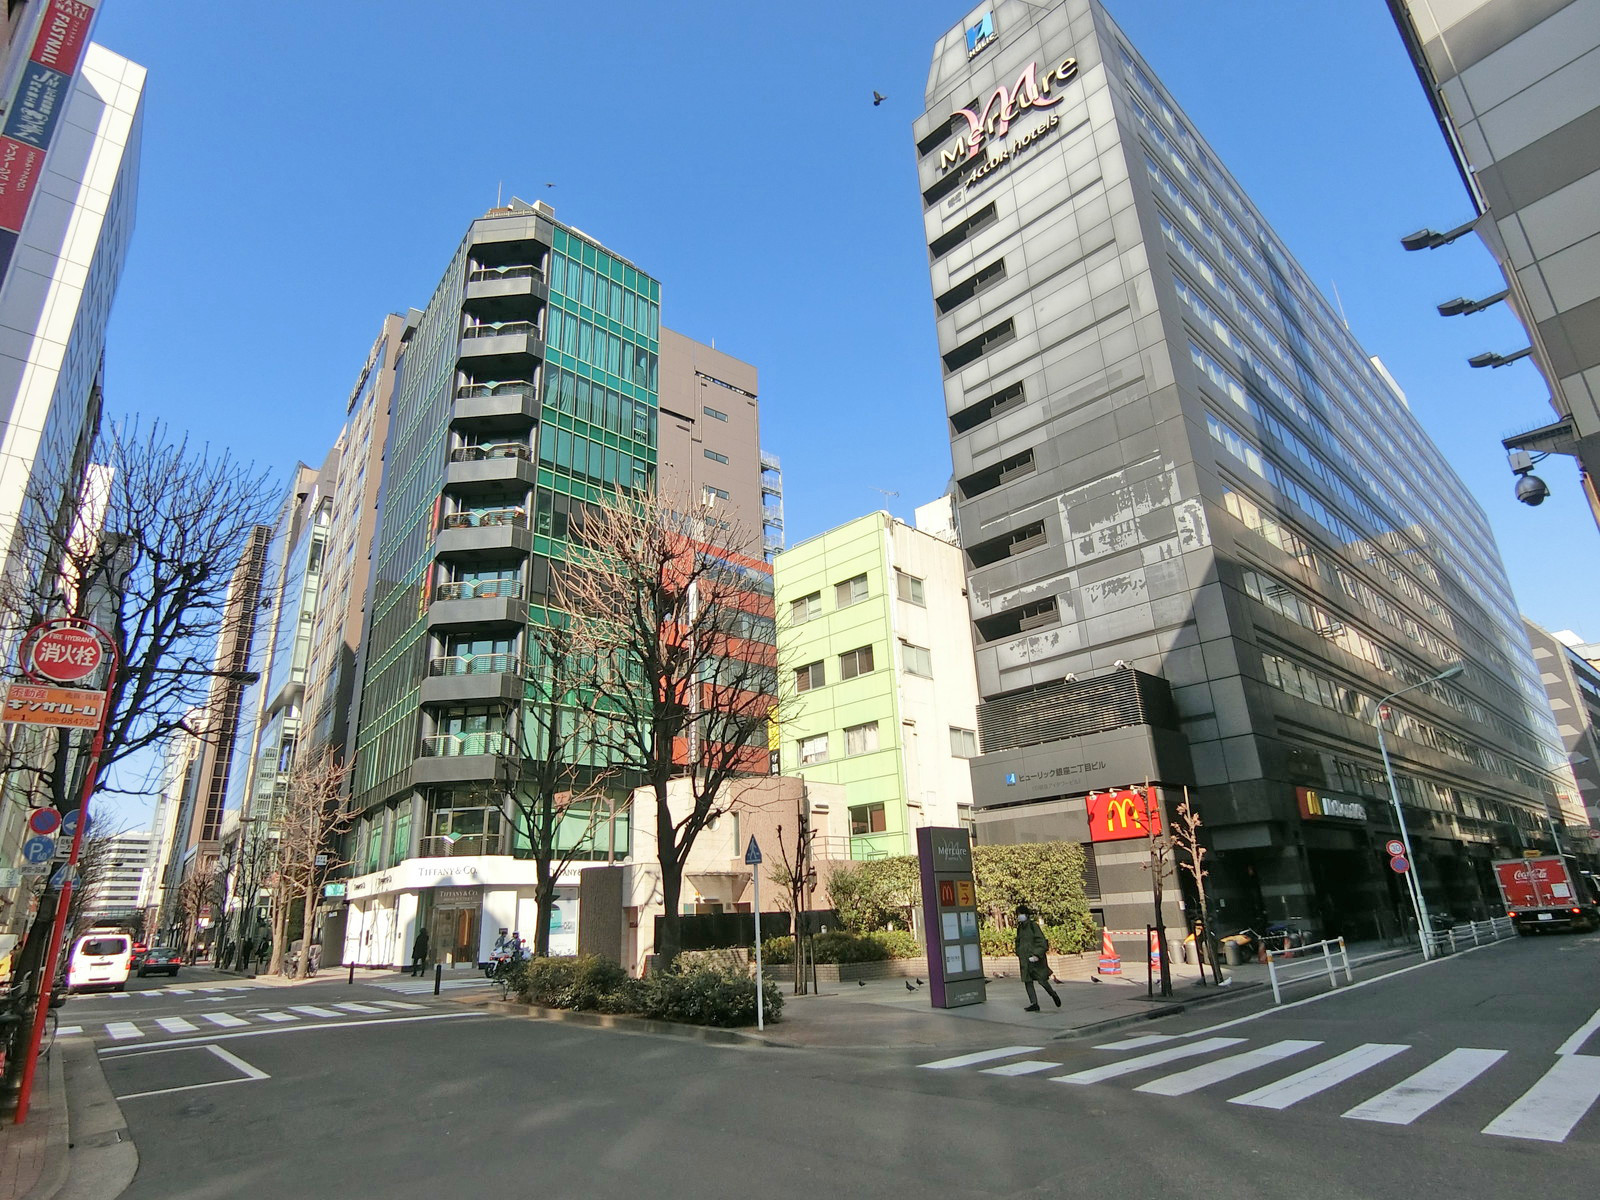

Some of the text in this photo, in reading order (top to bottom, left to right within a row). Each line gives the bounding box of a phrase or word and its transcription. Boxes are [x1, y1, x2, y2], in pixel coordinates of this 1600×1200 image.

[41, 12, 70, 65] FASTNAIL
[940, 56, 1079, 170] Mercure
[965, 113, 1059, 187] ACCOR hotels
[49, 632, 94, 644] FIRE HYDRANT
[38, 641, 97, 667] 消火栓
[11, 687, 46, 699] 不動産
[1018, 760, 1107, 783] ヒューリック銀座二丁目ビル
[938, 846, 967, 856] Mercure
